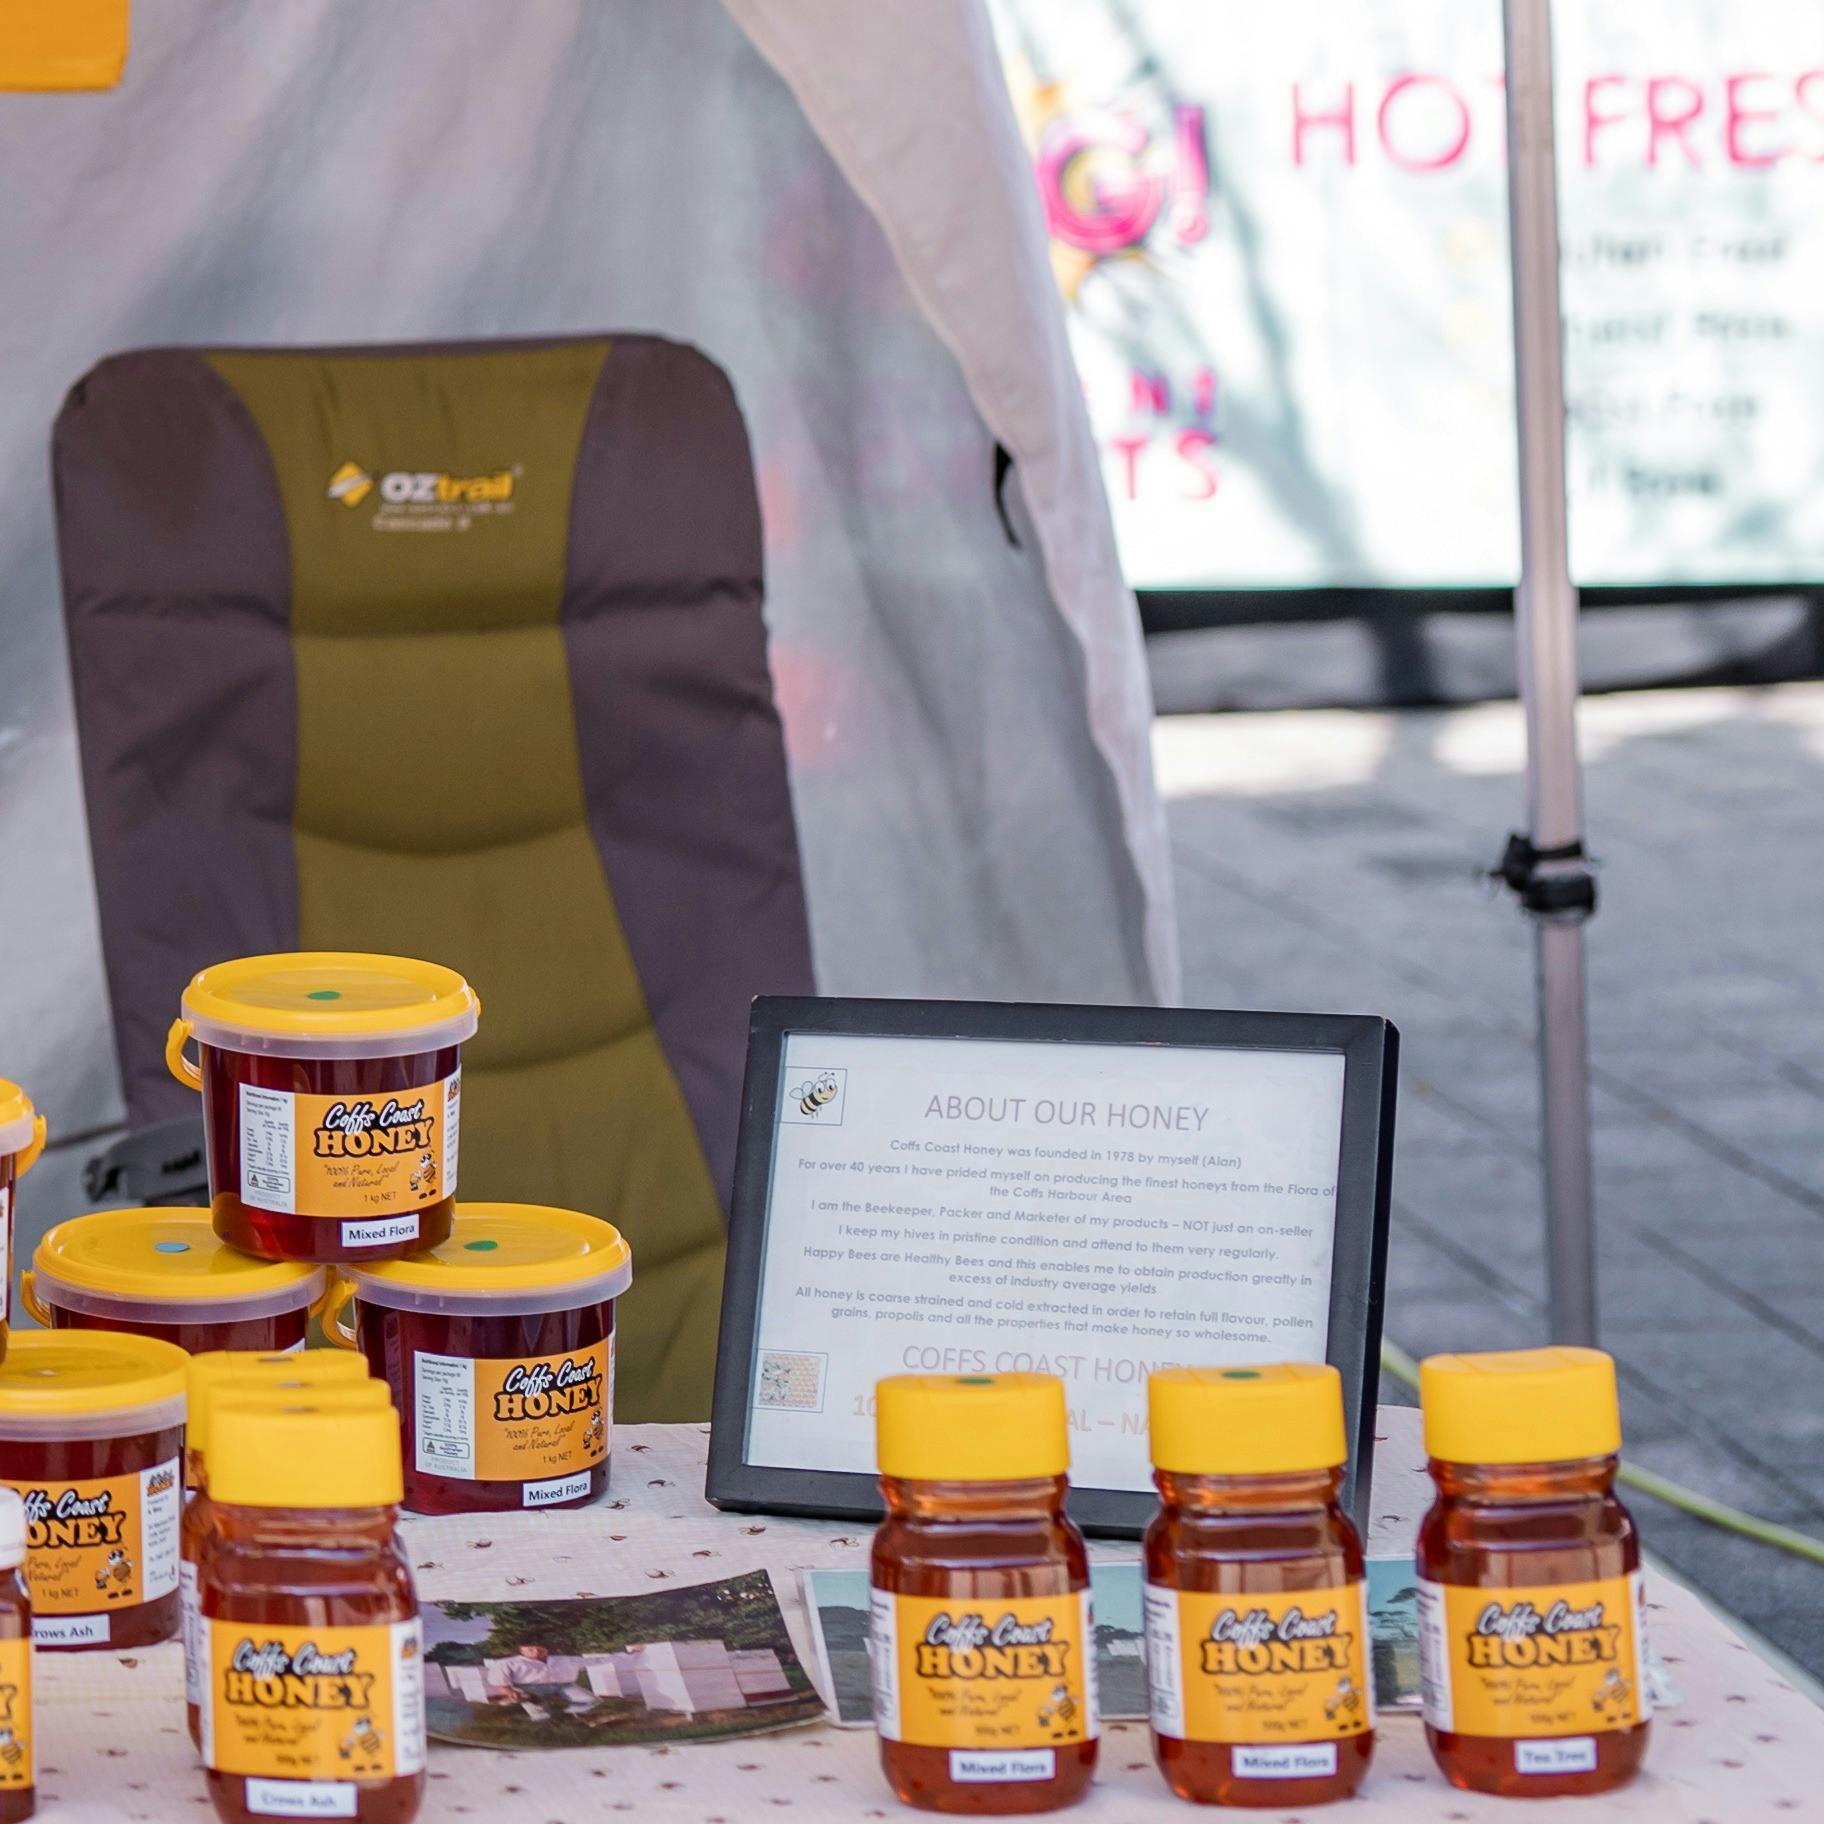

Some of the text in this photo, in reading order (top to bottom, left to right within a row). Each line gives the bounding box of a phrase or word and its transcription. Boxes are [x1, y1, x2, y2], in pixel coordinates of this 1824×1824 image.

[1290, 71, 1507, 172] HO
[325, 1099, 425, 1135] Coffs Coast
[924, 1095, 1209, 1132] ABOUT OUR HONEY
[314, 1116, 435, 1157] HONEY
[890, 1139, 1241, 1170] Coffs Coast Honey was founded in 1978 by myself (Alan)
[799, 1158, 1336, 1198] For over 40 years I have prided myself on producing the finest honeys from the Flora of
[990, 1186, 1132, 1203] the Coffs Harbour Area
[370, 1193, 380, 1204] kg
[381, 1191, 397, 1201] NET
[348, 1224, 415, 1240] Mixed Flora
[832, 1306, 1271, 1343] grains, propolis and all the properties that make honey so wholesome.
[505, 1358, 594, 1399] Coffs Coast
[902, 1345, 987, 1374] COFFS
[1093, 1358, 1192, 1385] HON
[494, 1373, 602, 1421] HONEY
[56, 1490, 111, 1519] Coast
[528, 1482, 588, 1501] Mixed Flora
[26, 1511, 127, 1549] ONEY
[32, 1625, 94, 1639] rows Ash
[1467, 1625, 1620, 1669] HONEY
[916, 1641, 1070, 1679] HONEY
[1200, 1632, 1353, 1674] HONEY
[225, 1669, 374, 1710] HONEY
